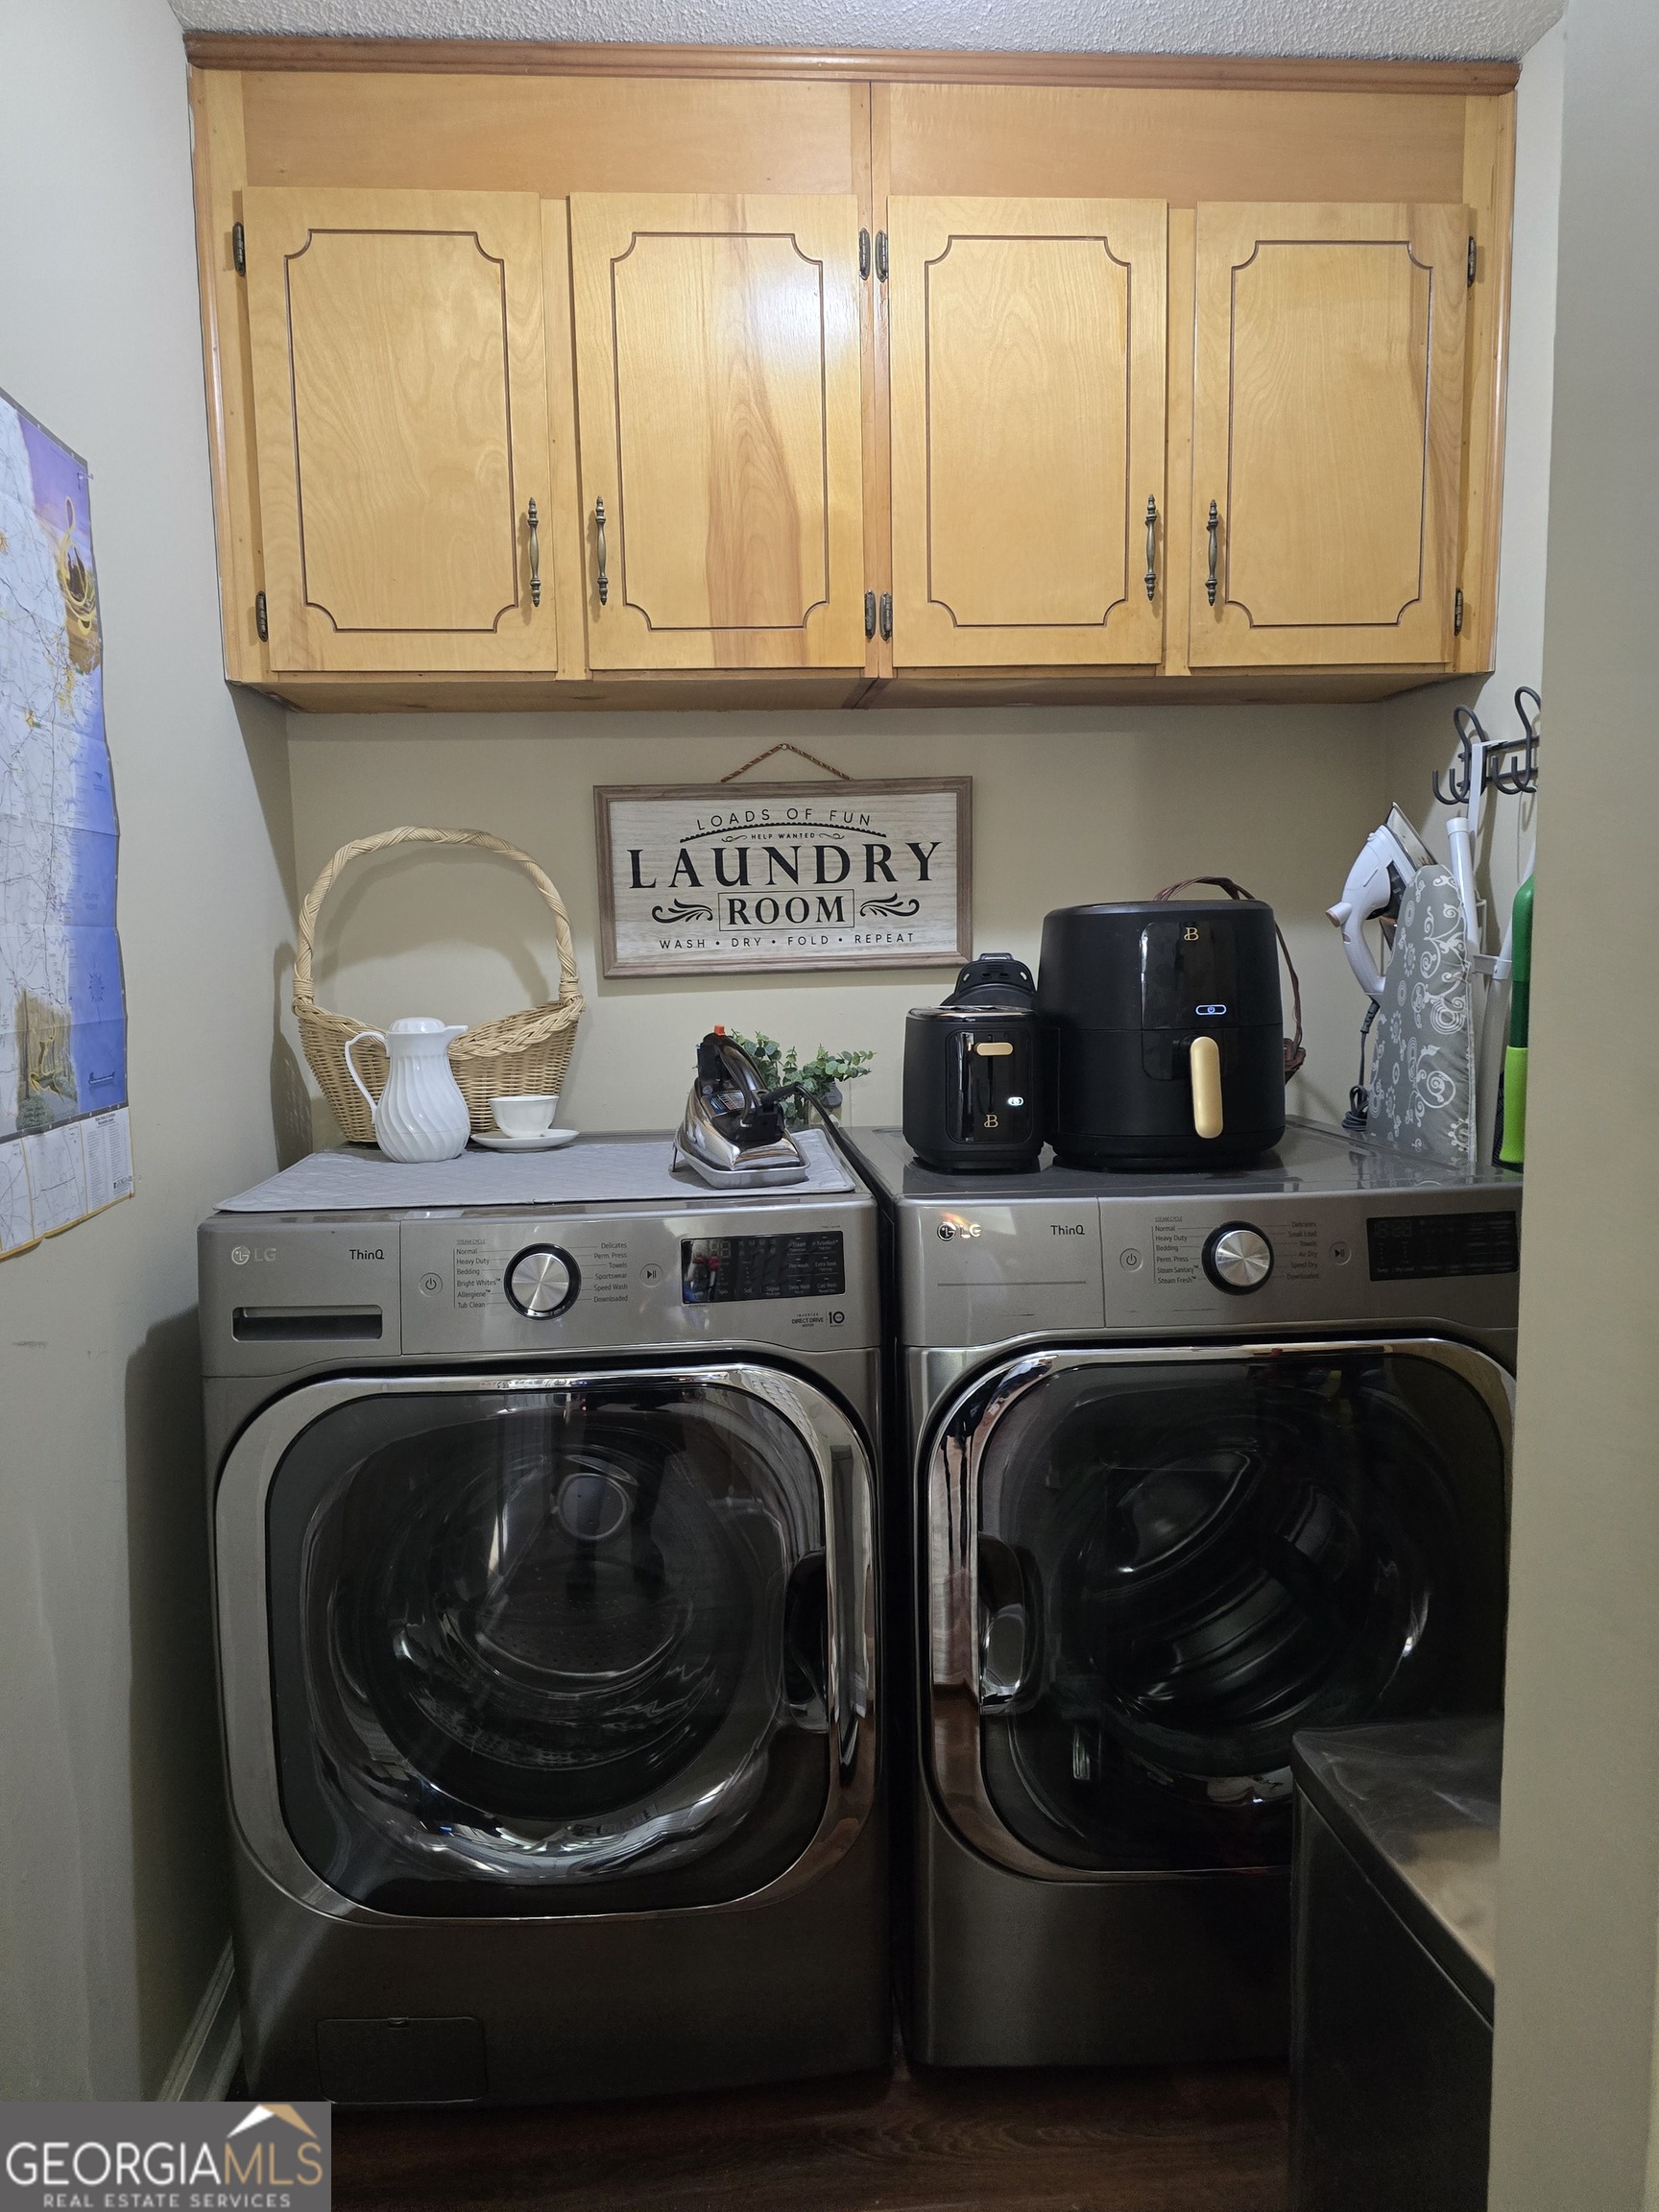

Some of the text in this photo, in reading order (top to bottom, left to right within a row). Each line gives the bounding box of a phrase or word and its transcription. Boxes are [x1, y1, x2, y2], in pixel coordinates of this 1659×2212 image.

[697, 807, 871, 831] LOADS OF FUN
[778, 831, 816, 840] WANTED
[626, 841, 943, 889] LAUNDRY
[727, 895, 846, 926] ROOM
[659, 932, 915, 950] WASH DRY FOLD REPEAT
[1050, 1224, 1085, 1236] ThinQ
[349, 1249, 385, 1261] ThinQ
[456, 1258, 474, 1266] Heavy
[456, 1280, 475, 1288] Bright
[593, 1284, 612, 1292] Speed
[593, 1294, 629, 1303] Downloaded
